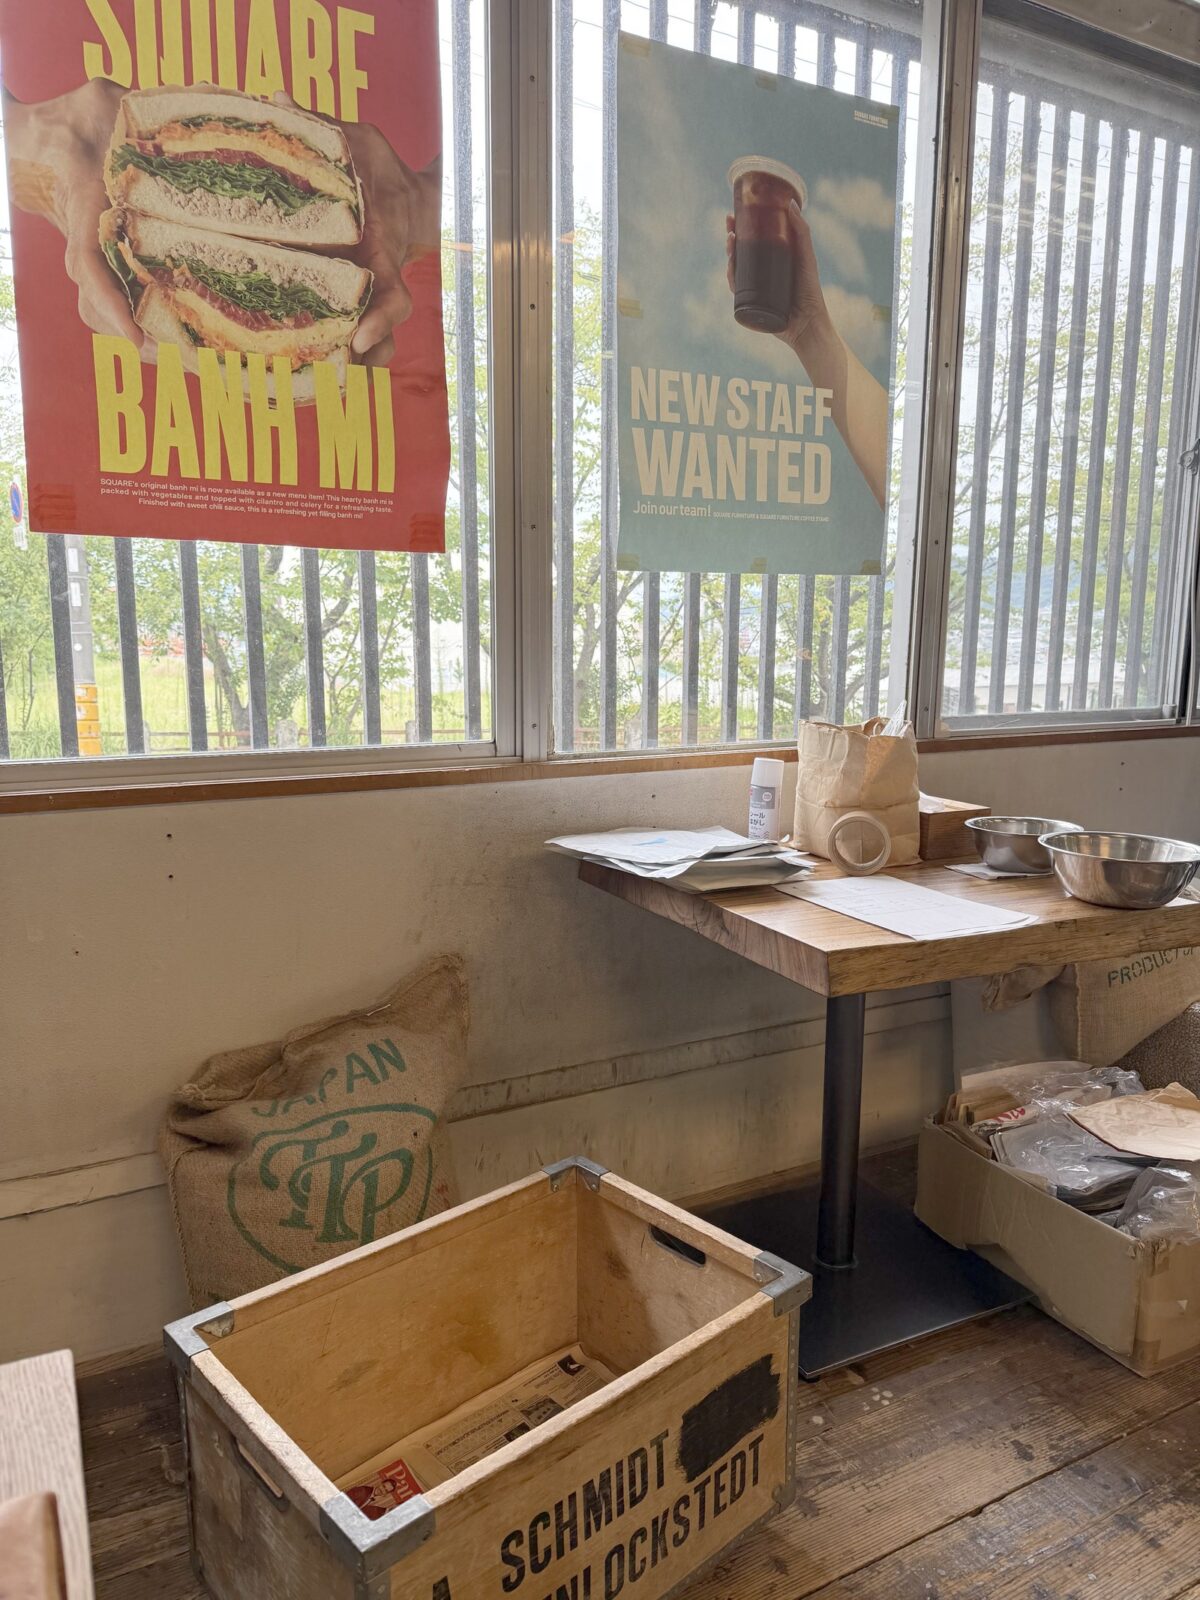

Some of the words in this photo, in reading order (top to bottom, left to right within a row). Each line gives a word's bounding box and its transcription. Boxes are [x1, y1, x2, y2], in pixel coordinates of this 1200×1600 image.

[92, 334, 298, 485] BANH
[313, 360, 395, 493] MI
[631, 366, 721, 426] NEW
[726, 377, 833, 436] STAFF
[632, 427, 832, 505] WANTED
[100, 479, 138, 488] SQUARE's
[140, 482, 168, 490] original
[224, 488, 255, 496] available
[341, 496, 361, 504] hearty
[100, 488, 129, 496] packed
[151, 492, 192, 500] vegetables
[300, 501, 321, 509] celery
[341, 504, 374, 512] refreshing
[139, 498, 168, 506] Finished
[170, 500, 185, 508] with
[224, 505, 246, 513] sauce,
[274, 508, 306, 517] refreshing
[319, 510, 336, 519] filling
[633, 500, 657, 515] Join
[659, 504, 678, 516] our
[680, 504, 711, 517] team!
[501, 1429, 669, 1593] SCHMIDT
